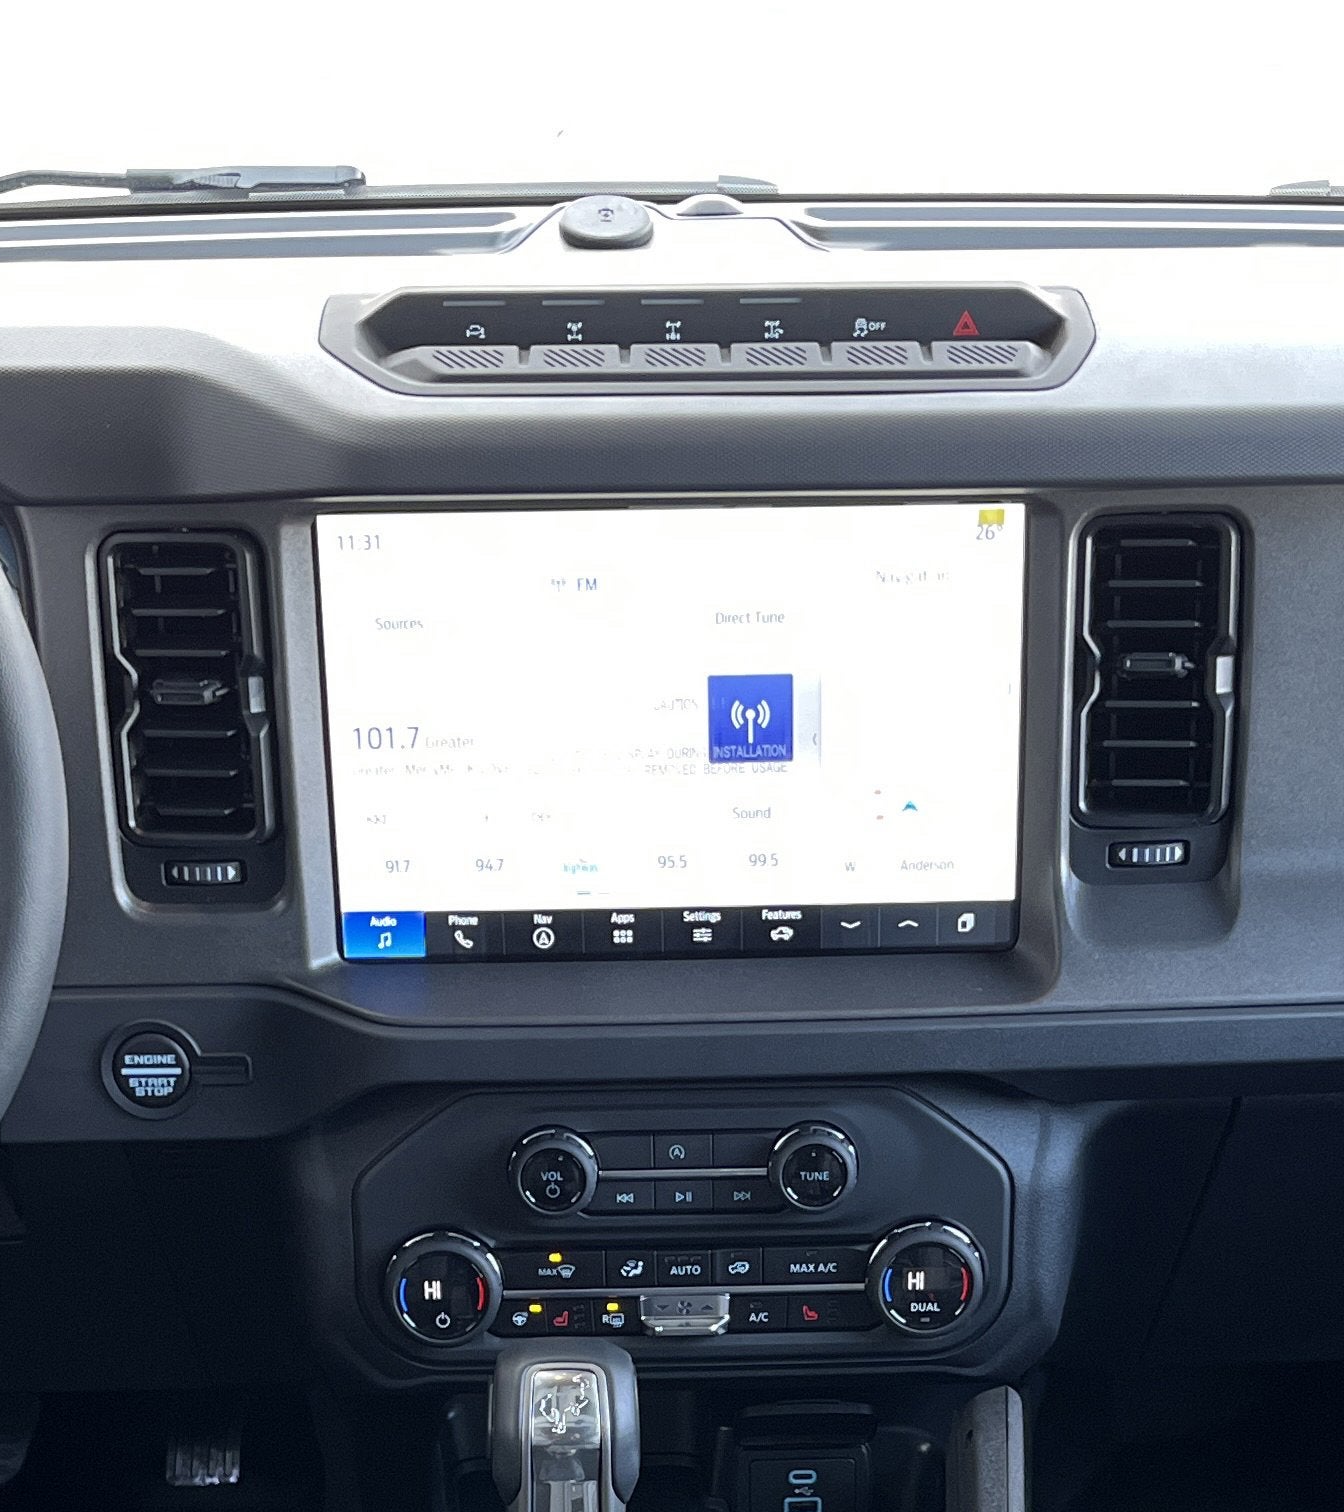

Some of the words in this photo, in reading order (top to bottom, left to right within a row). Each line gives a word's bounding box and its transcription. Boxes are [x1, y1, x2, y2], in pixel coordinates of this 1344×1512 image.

[868, 321, 886, 330] OFF
[577, 578, 597, 591] FM
[716, 612, 750, 624] Direct
[756, 611, 785, 623] Tune
[375, 618, 423, 630] Sources
[353, 727, 419, 750] 101.7
[713, 744, 786, 758] INSTALLATION
[733, 808, 771, 820] Sound
[385, 860, 410, 873] 91.7
[475, 858, 504, 871] 94.7
[658, 855, 687, 869] 95.5
[749, 854, 778, 867] 99.5
[901, 859, 954, 871] Anderson
[534, 914, 552, 924] Nav
[611, 913, 634, 925] Apps
[683, 911, 721, 923] Settings
[762, 909, 802, 920] Features
[370, 916, 396, 927] Audio
[448, 915, 478, 926] Phone
[124, 1054, 176, 1064] ENGINE
[129, 1077, 176, 1087] START
[136, 1087, 173, 1097] STOP
[541, 1171, 564, 1181] VOL
[800, 1171, 829, 1181] TUNE
[538, 1268, 556, 1276] MAX
[670, 1265, 701, 1276] AUTO
[790, 1263, 815, 1273] MAX
[819, 1262, 837, 1273] A/C
[908, 1271, 924, 1290] HI
[423, 1280, 441, 1300] HI
[910, 1302, 940, 1312] DUAL
[602, 1314, 609, 1324] R
[749, 1312, 769, 1322] A/C
